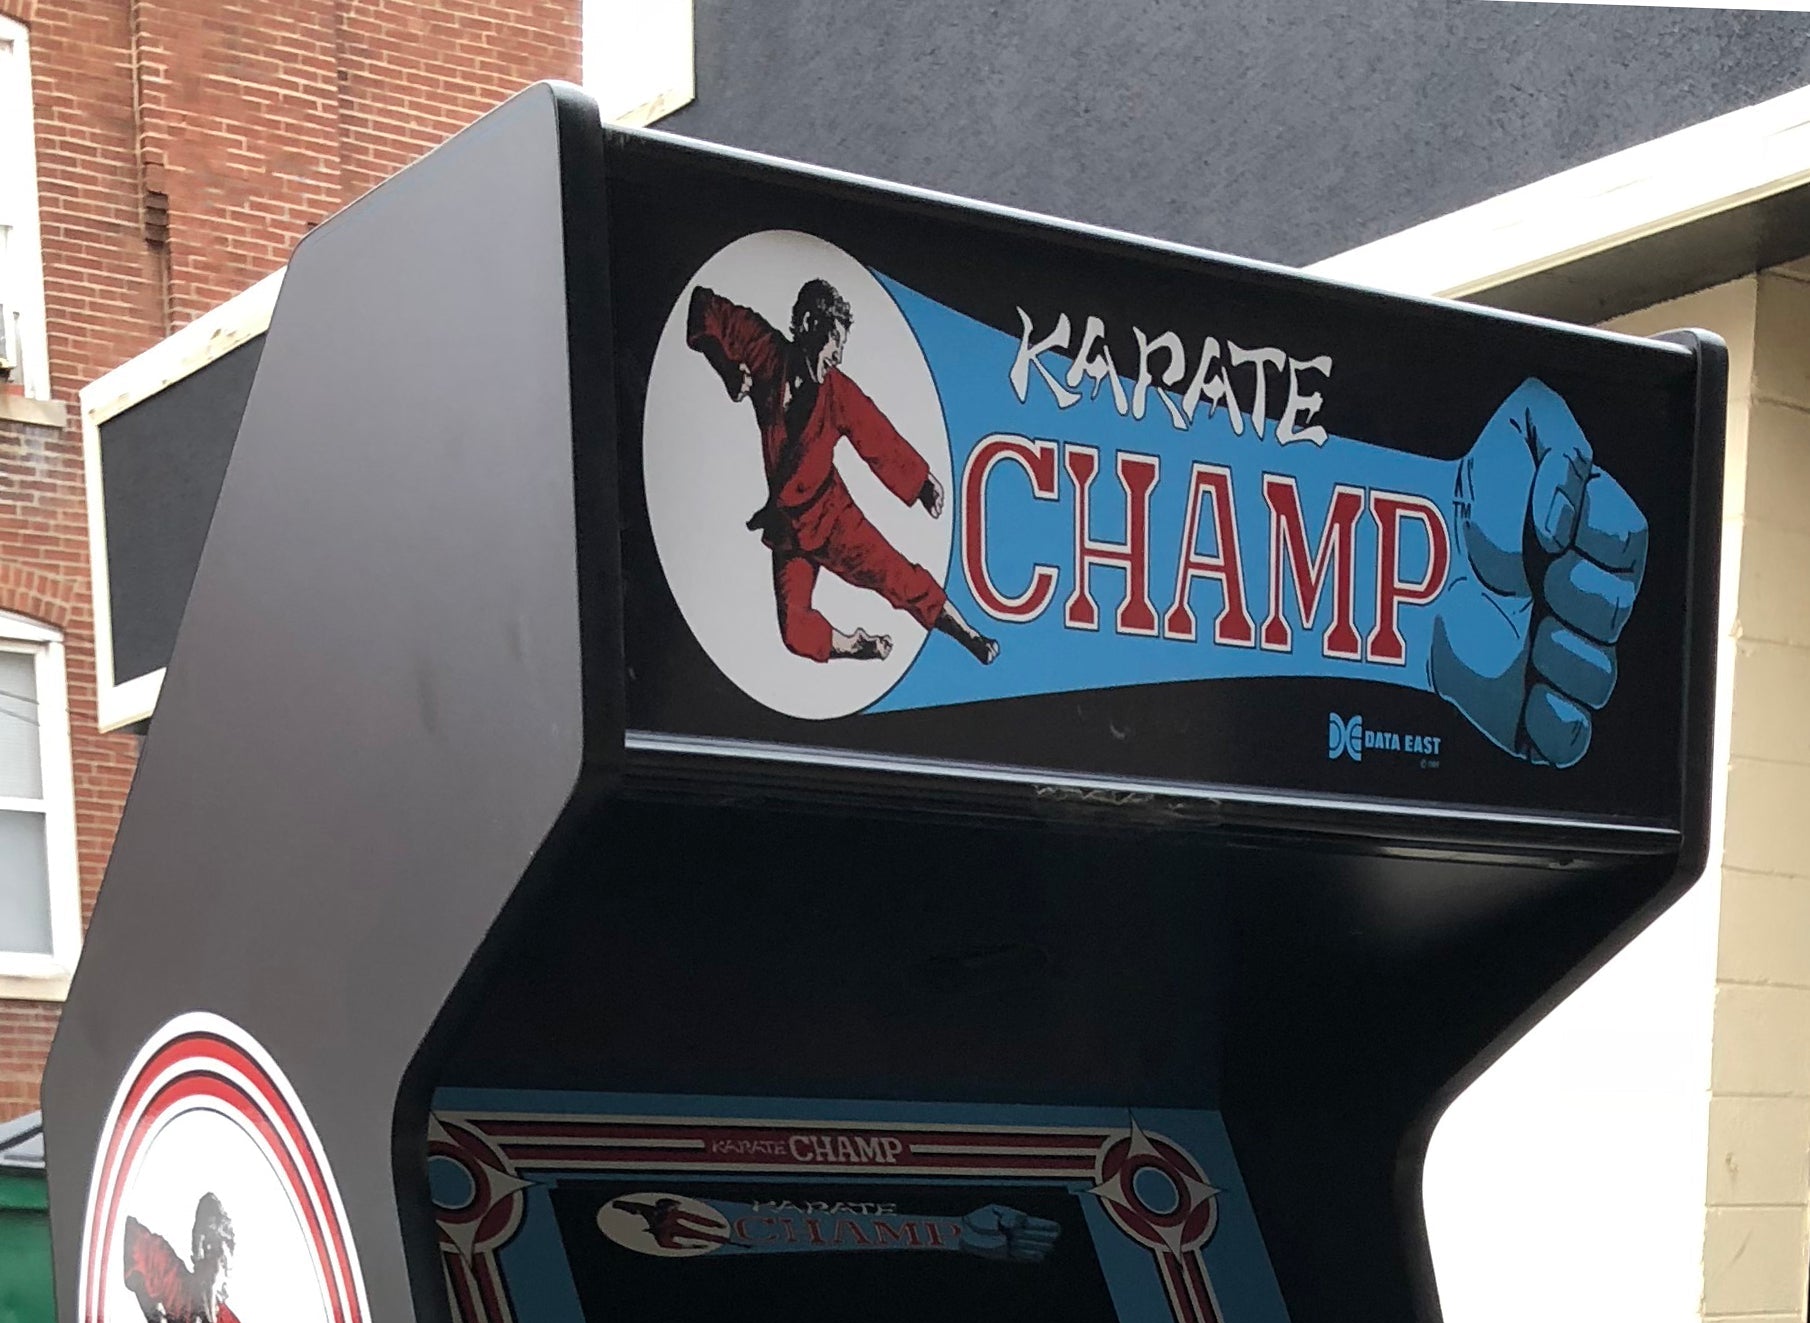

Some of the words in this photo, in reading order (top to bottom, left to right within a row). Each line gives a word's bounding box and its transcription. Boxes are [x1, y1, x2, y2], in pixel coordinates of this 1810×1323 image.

[1008, 305, 1332, 447] KARATE
[961, 432, 1452, 666] CHAMP
[1364, 730, 1400, 751] DATA
[1404, 734, 1441, 755] EAST
[711, 1139, 787, 1156] KARATE
[788, 1134, 903, 1164] CHAMP
[733, 1215, 963, 1248] CHAMP
